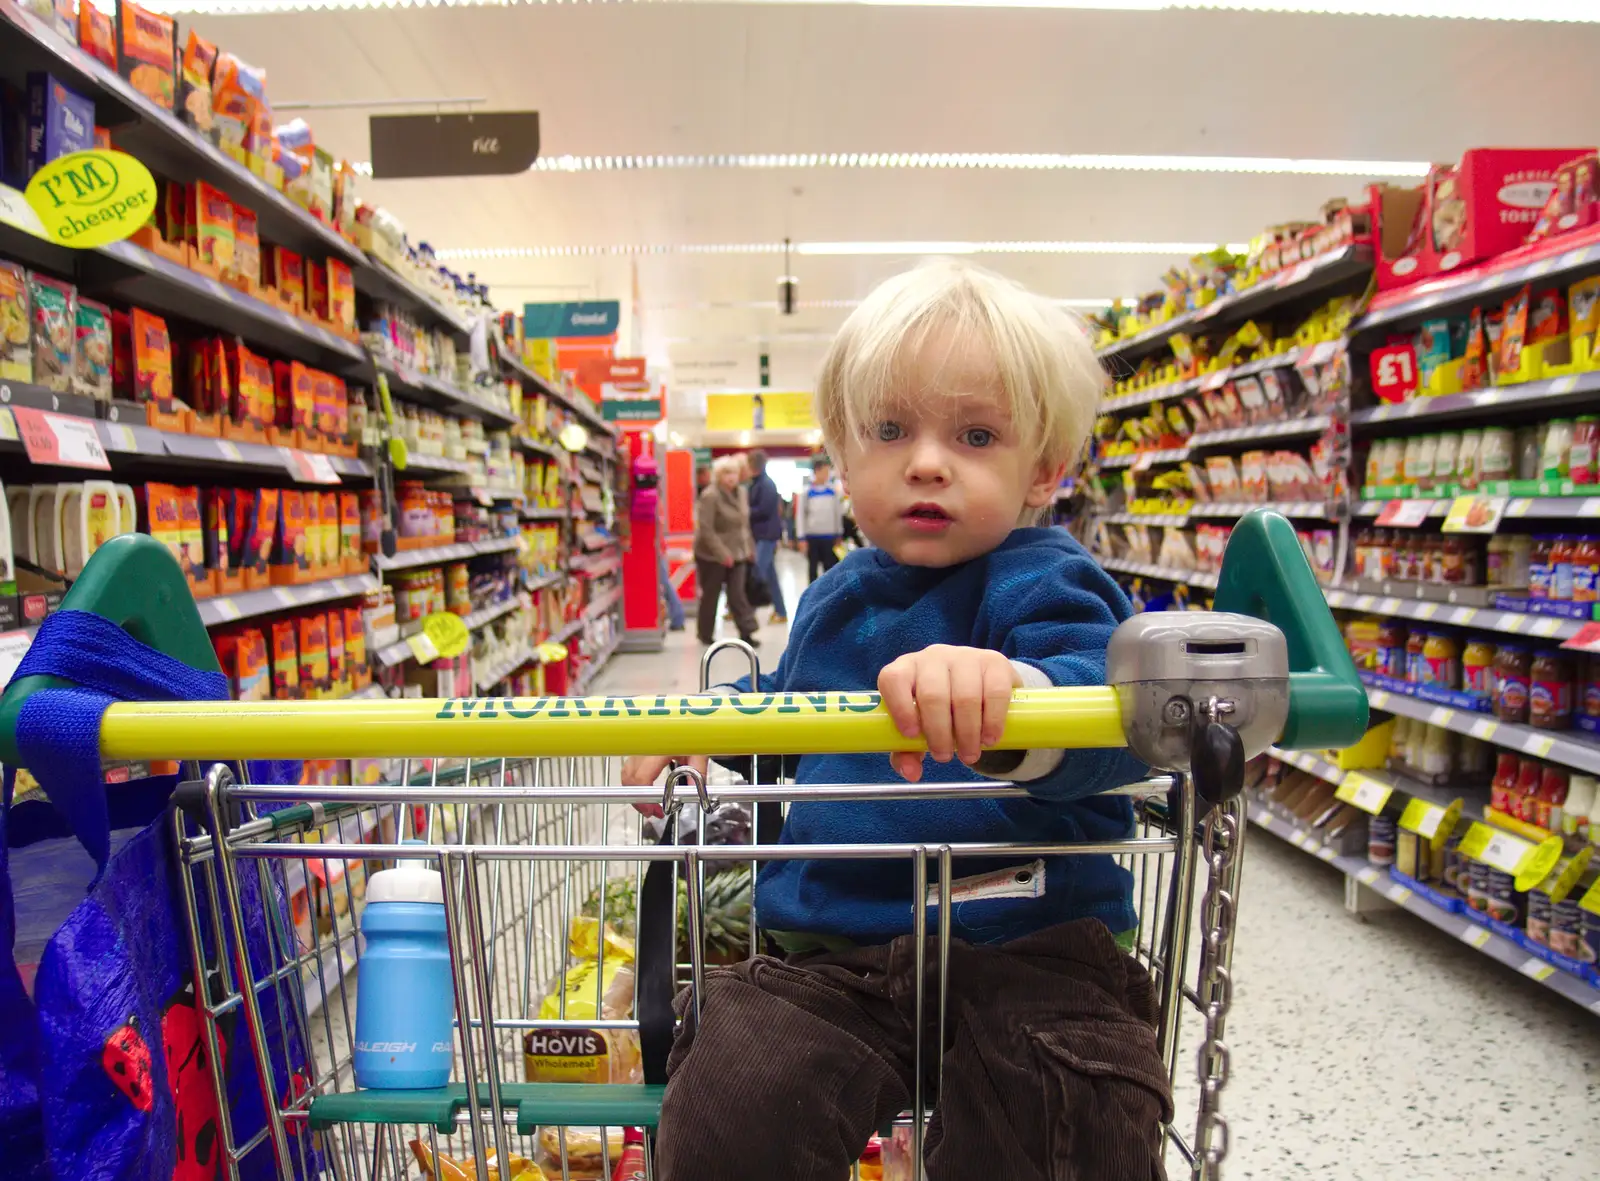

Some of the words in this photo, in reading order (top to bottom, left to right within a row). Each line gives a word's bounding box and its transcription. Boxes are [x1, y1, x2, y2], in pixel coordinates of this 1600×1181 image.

[472, 136, 501, 155] rice
[40, 161, 110, 208] I'M
[1502, 169, 1559, 185] MEXICA
[58, 189, 148, 239] cheaper
[1499, 209, 1537, 224] TORT
[1376, 351, 1412, 387] £1
[355, 1040, 417, 1053] ALEIGH
[431, 1040, 454, 1053] RA
[534, 1058, 595, 1069] Wholemeal
